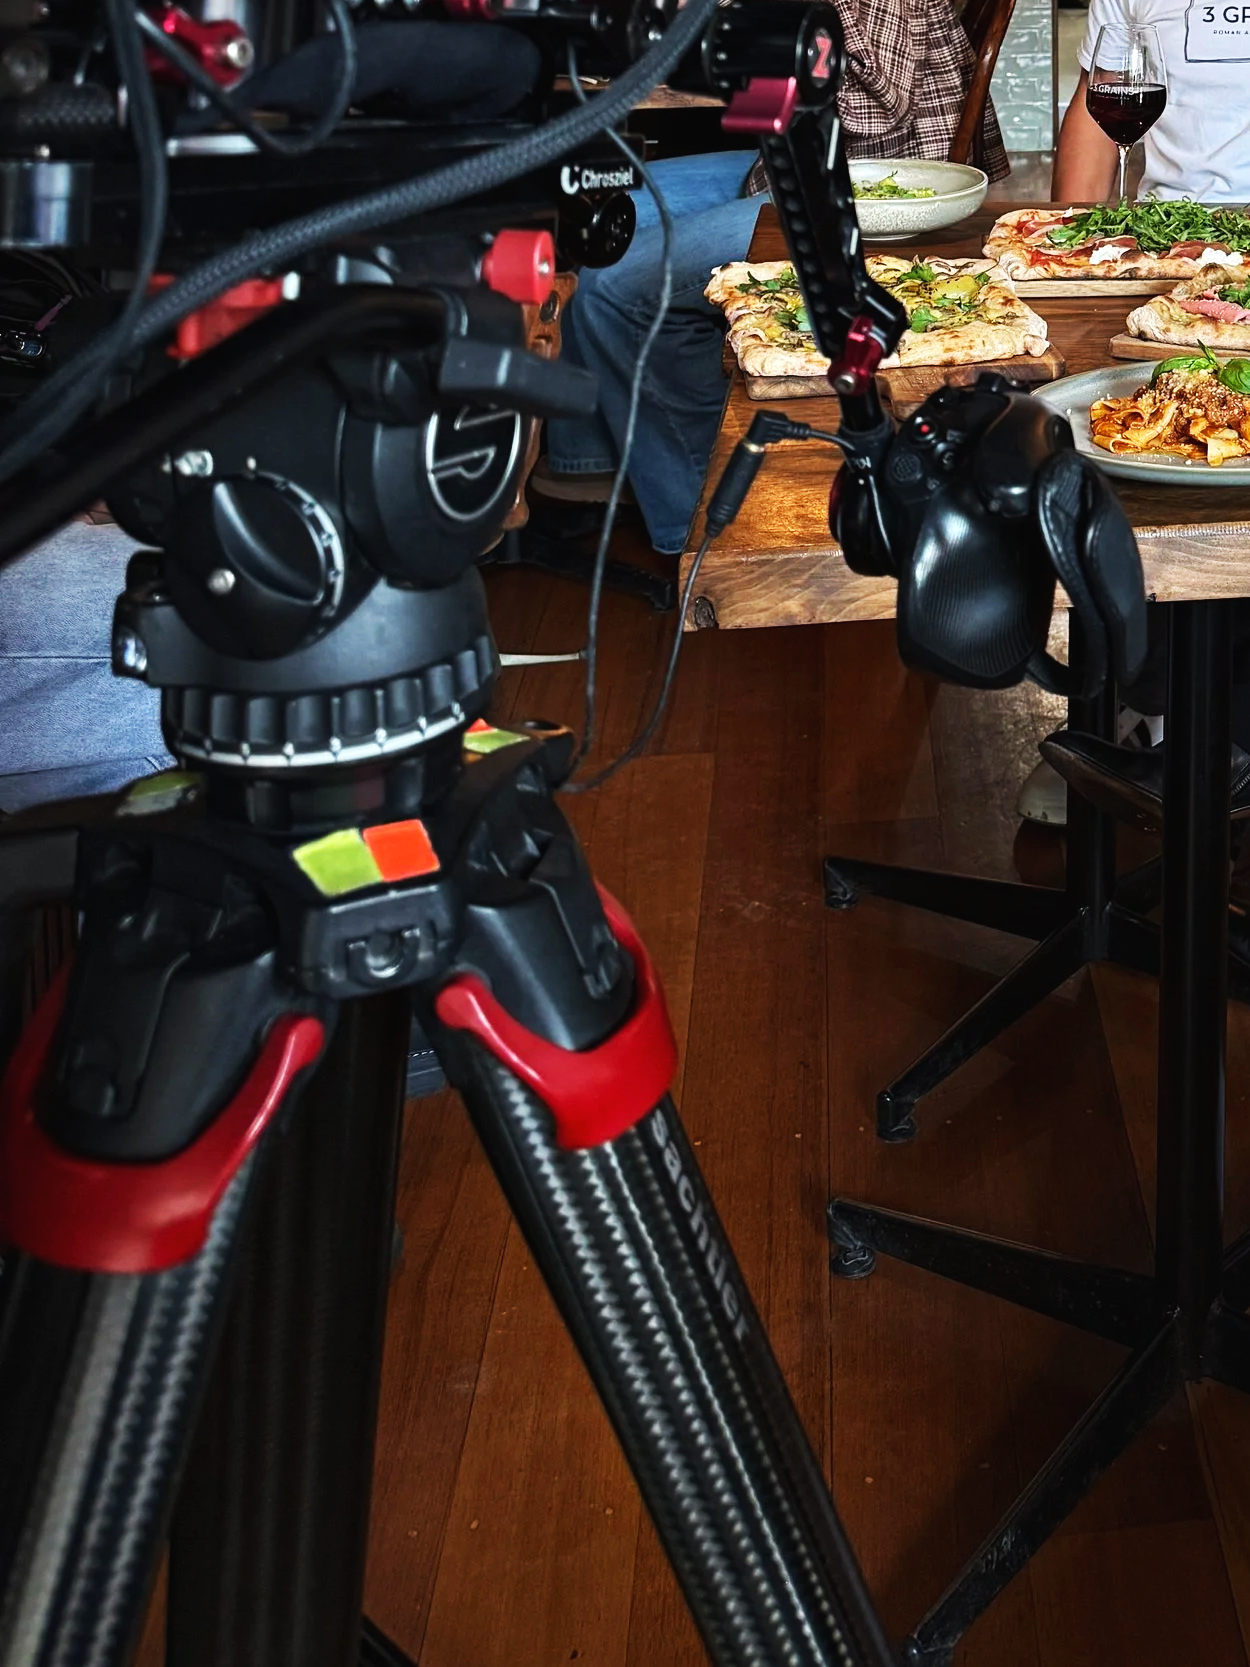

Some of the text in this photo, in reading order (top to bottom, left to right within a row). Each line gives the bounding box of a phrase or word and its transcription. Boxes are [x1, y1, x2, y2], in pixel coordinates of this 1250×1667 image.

[1202, 6, 1215, 23] 3
[1099, 84, 1134, 95] GRAINS
[581, 167, 634, 190] Chrosziel
